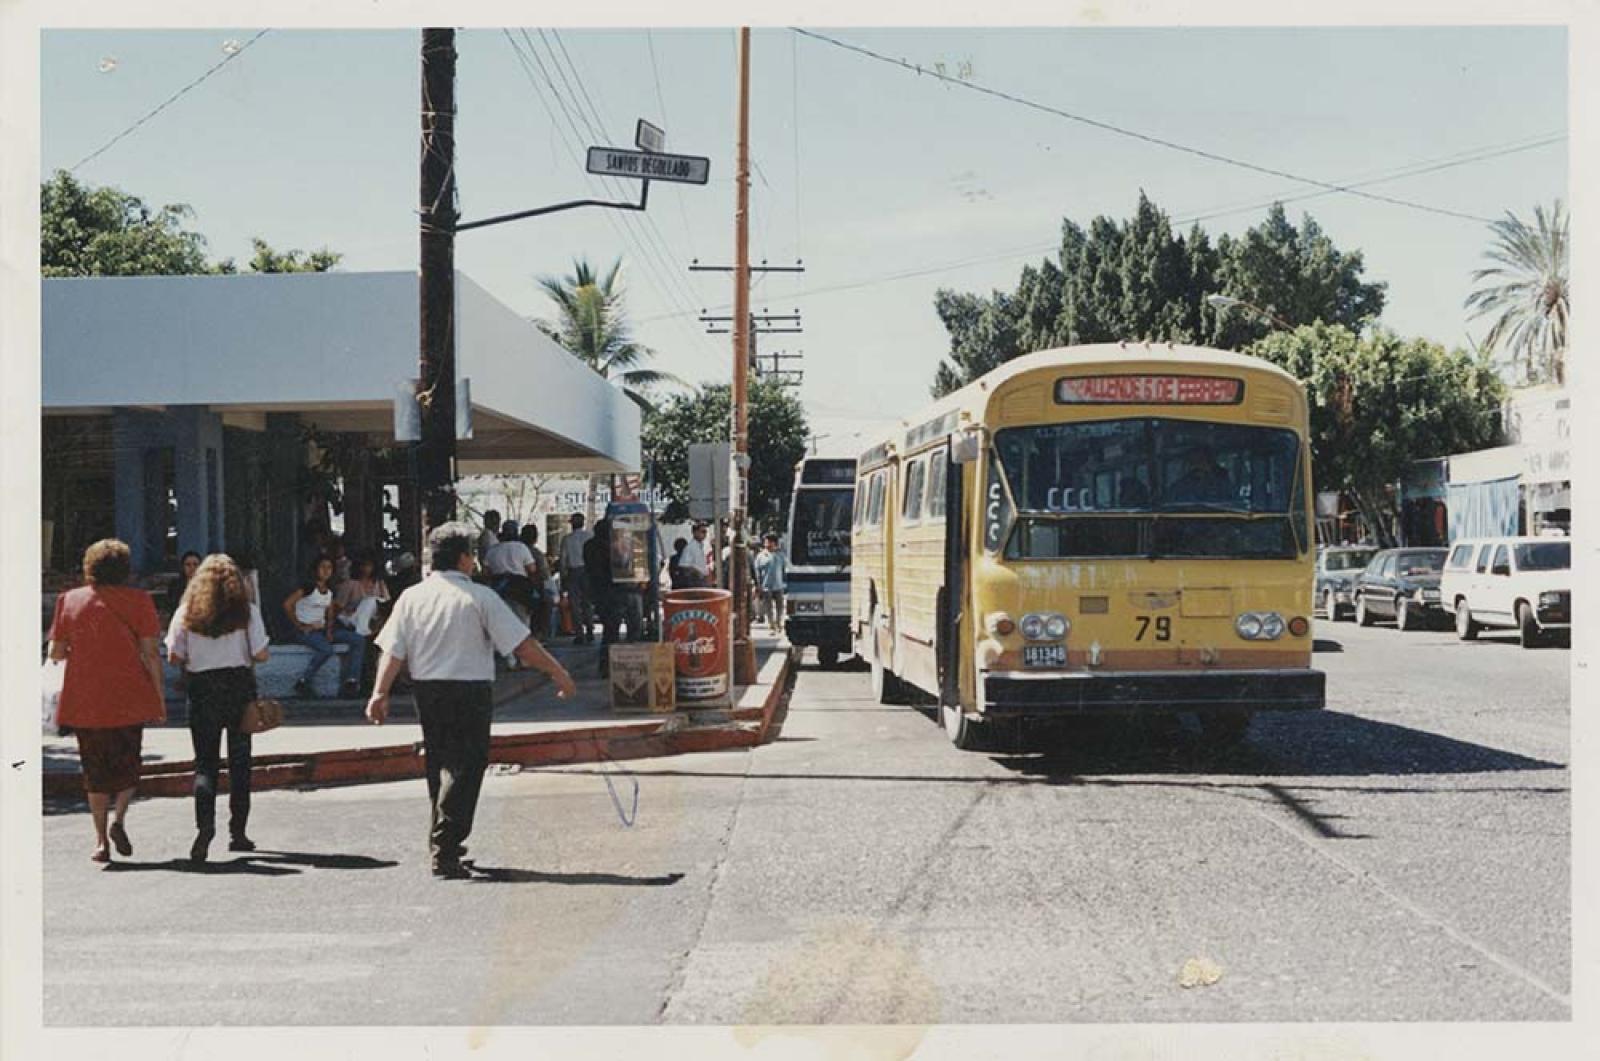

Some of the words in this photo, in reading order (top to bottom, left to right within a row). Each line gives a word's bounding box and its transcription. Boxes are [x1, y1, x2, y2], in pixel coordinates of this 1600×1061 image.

[606, 153, 639, 172] SANTOS
[1156, 378, 1174, 401] DE
[1135, 615, 1171, 642] 79
